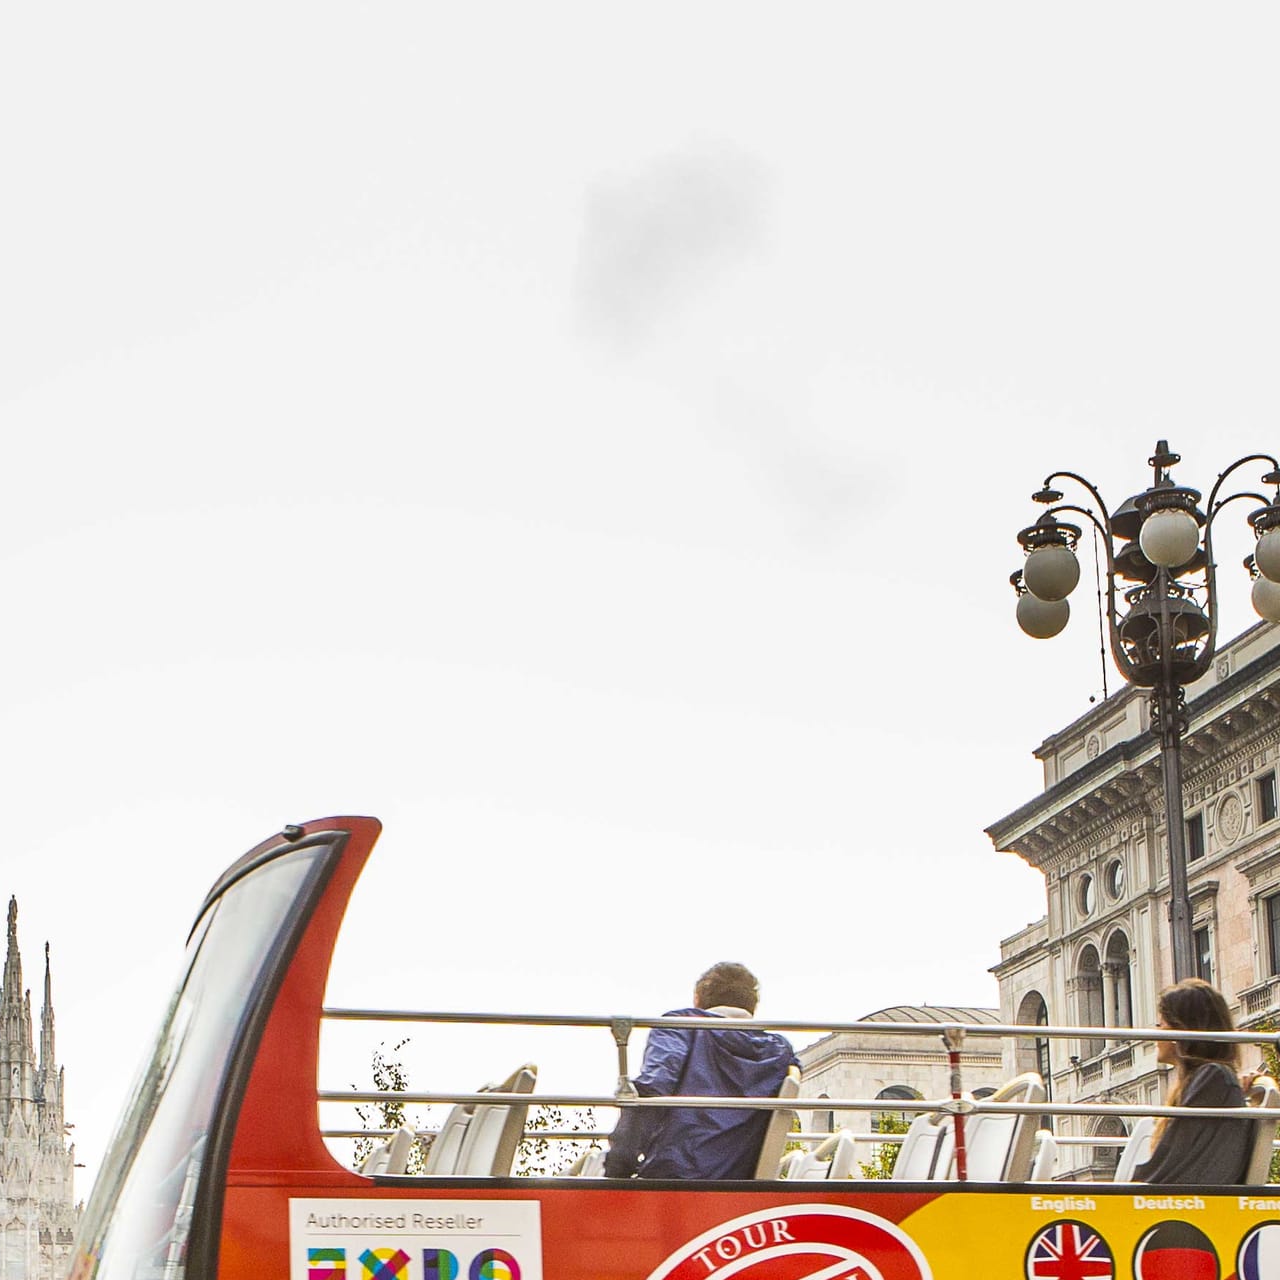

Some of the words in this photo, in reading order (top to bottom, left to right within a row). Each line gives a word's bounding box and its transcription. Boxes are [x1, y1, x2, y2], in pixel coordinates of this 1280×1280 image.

[1031, 1196, 1096, 1213] English
[1133, 1196, 1206, 1211] Deutsch
[306, 1212, 406, 1230] Authorised
[412, 1212, 484, 1230] Reseller
[692, 1219, 796, 1273] TOUR
